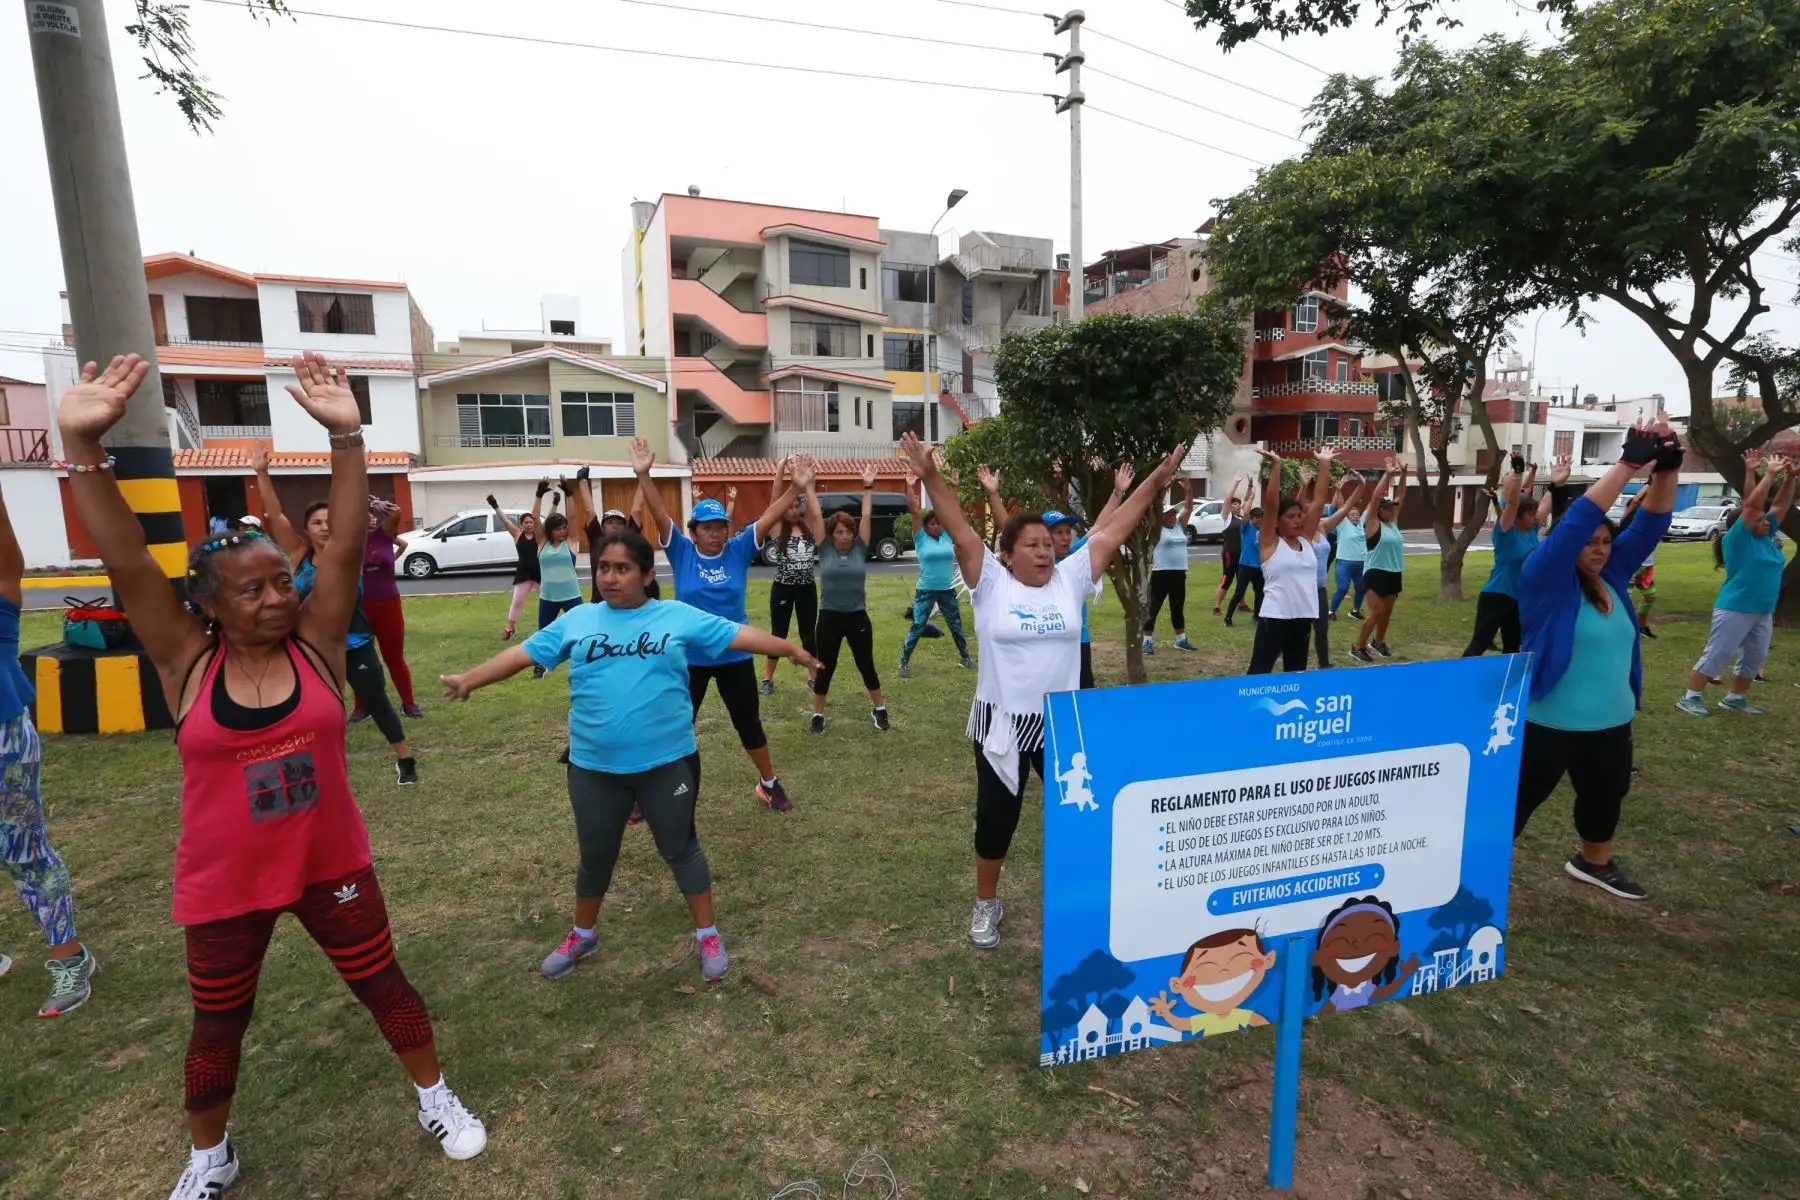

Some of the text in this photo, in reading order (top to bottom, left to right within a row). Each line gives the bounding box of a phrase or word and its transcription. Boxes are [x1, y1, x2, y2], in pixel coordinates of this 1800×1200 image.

[42, 13, 72, 24] MUERTE
[46, 20, 78, 33] VOLTAJE
[1020, 620, 1066, 634] miguel
[1042, 612, 1062, 622] san
[579, 632, 670, 664] Baila!
[1238, 684, 1300, 697] MUNICIPALIDAD
[1315, 694, 1352, 714] san
[1276, 711, 1352, 744] miguel
[1152, 762, 1440, 814] REGLAMENTO PARA EL USO DE JUEGOS INFANTILES
[1166, 793, 1380, 834] EL NIÑO DEBE ESTAR SUPERVISADO POR UN ADULTO.
[1166, 809, 1387, 852] EL USO DE LOS JUEGOS ES EXCLUSIVO PARA LOS NIÑOS.
[1164, 836, 1428, 890] EL USO DE LOS JUEGOS INFANTILES ES HASTA LAS 10 DE LA NOCHE.
[1165, 828, 1382, 872] LA ALTURA MÁXIMA DEL NIÑO DEBE SER DE 1.20 MTS.
[1232, 872, 1360, 906] EVITEMOS ACCIDENTES
